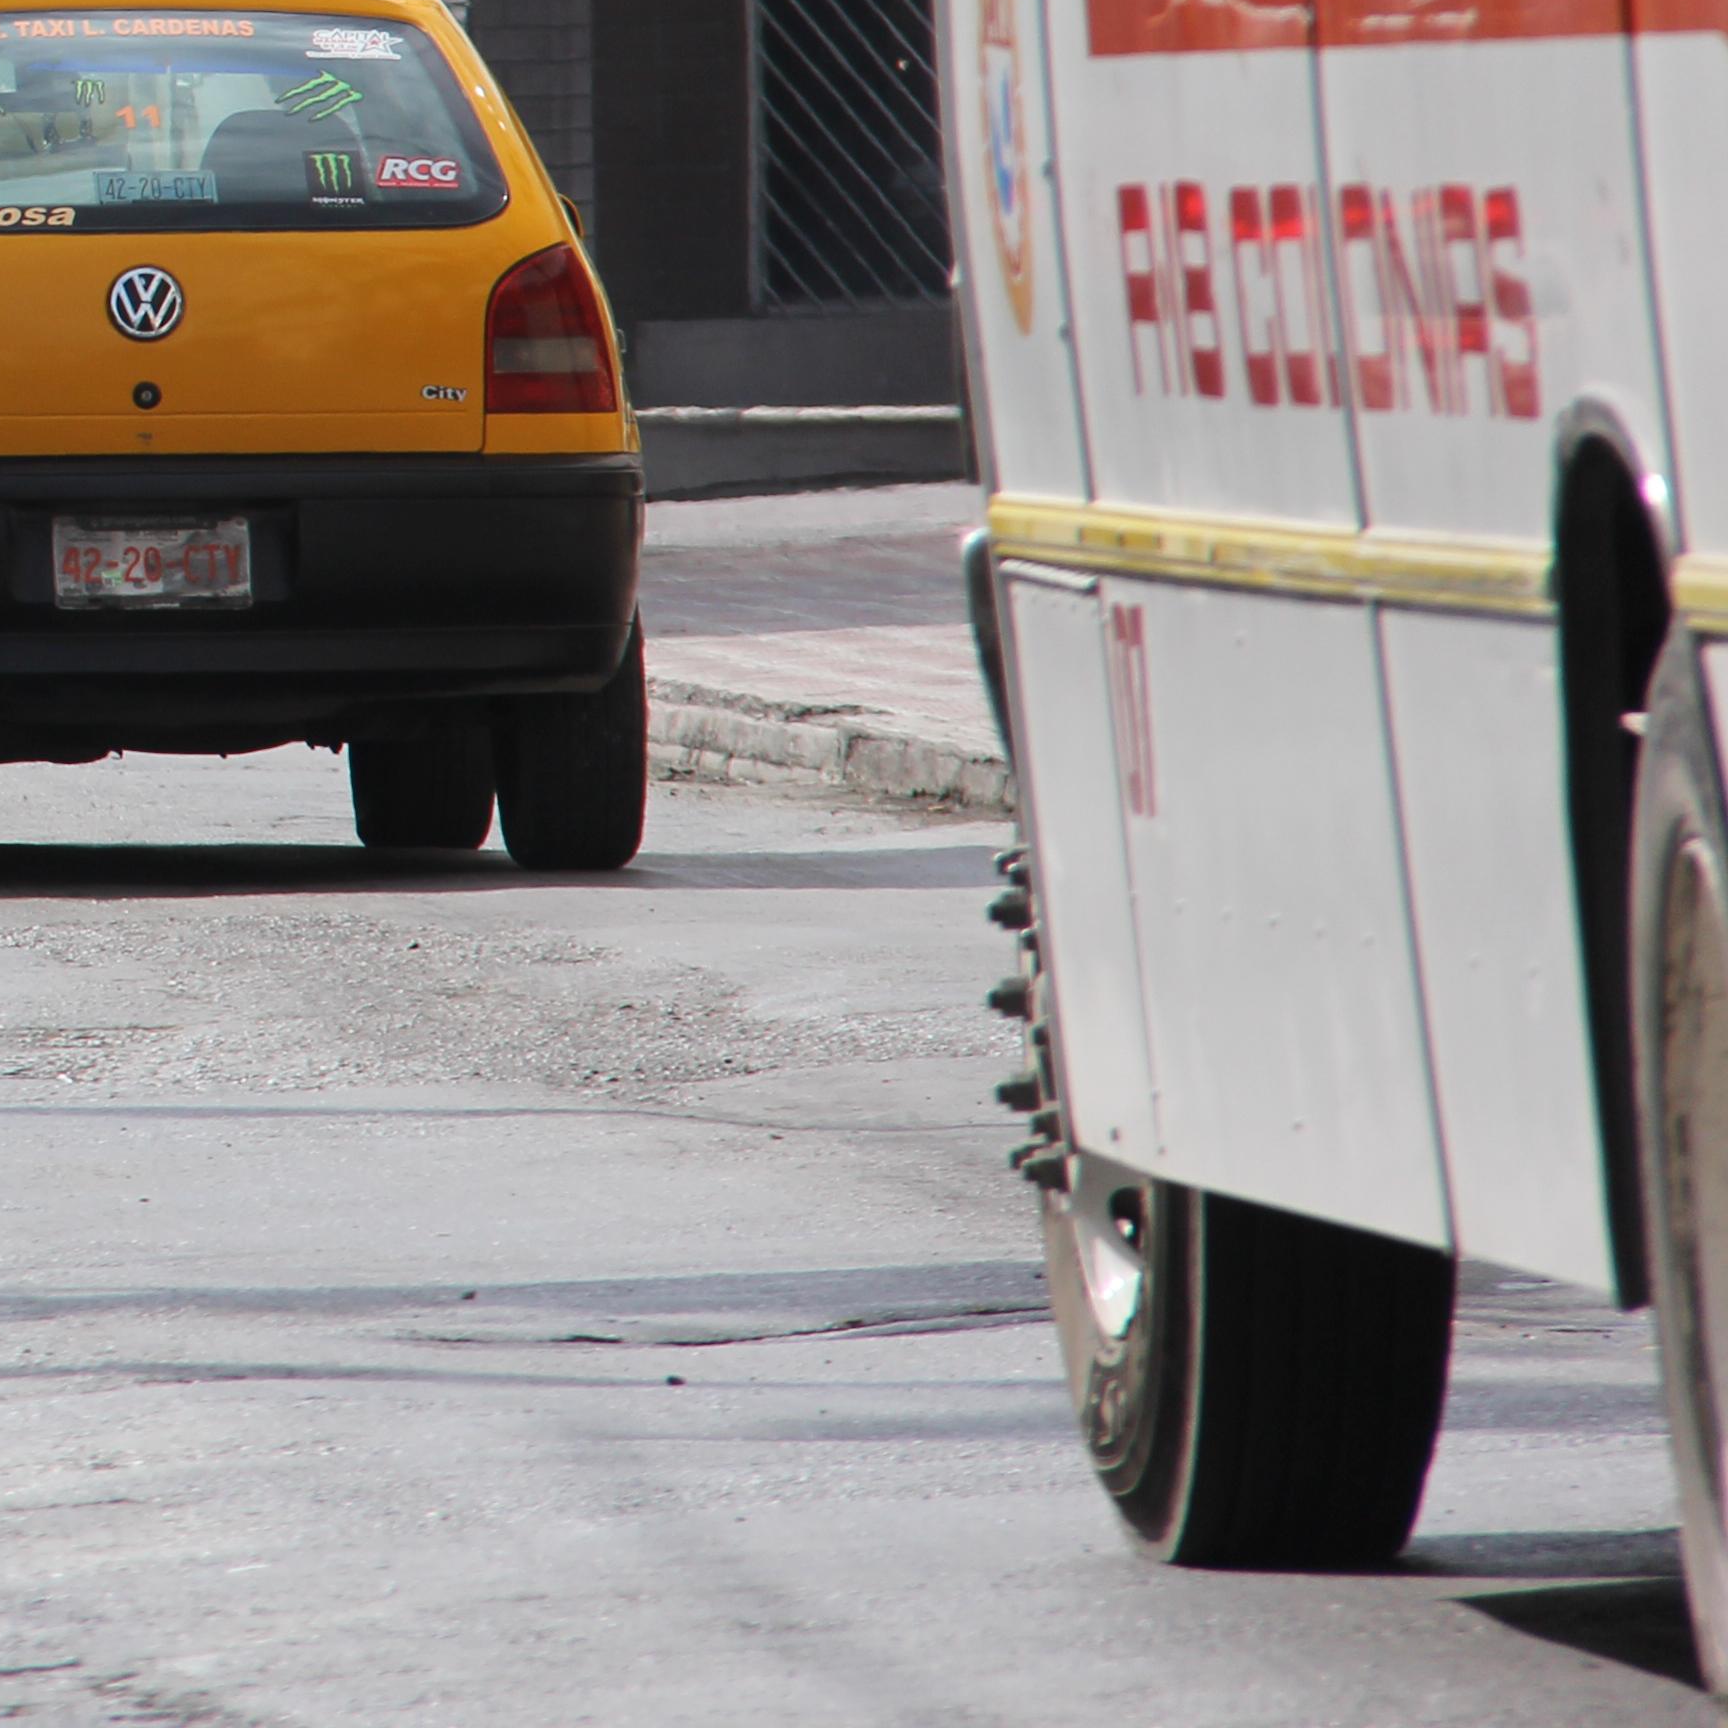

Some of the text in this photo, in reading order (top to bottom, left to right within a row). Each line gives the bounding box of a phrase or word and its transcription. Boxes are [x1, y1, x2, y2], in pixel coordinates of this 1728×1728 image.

[14, 19, 76, 39] TAXI
[82, 19, 106, 38] L.
[112, 17, 256, 38] CARDENAS
[115, 105, 162, 129] 11
[380, 157, 457, 182] RCG
[421, 384, 468, 403] City
[62, 542, 243, 586] 42-20-CTY
